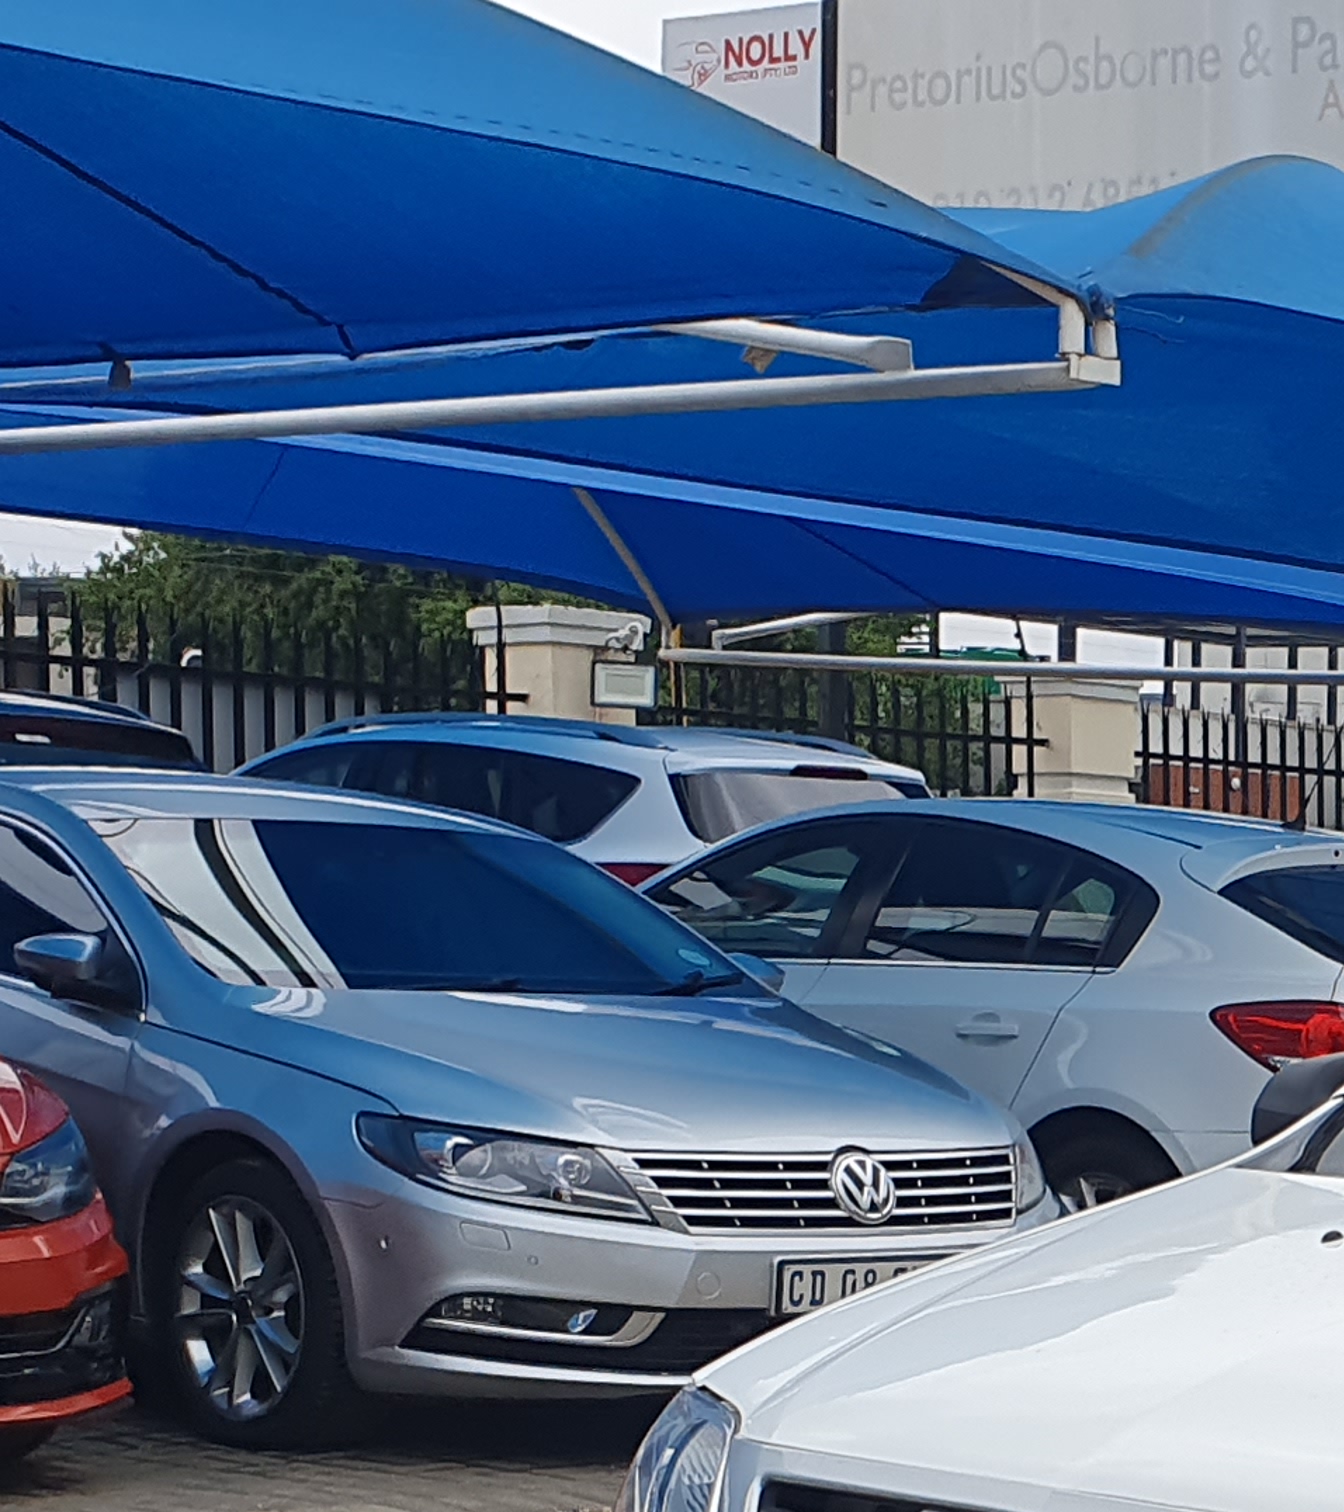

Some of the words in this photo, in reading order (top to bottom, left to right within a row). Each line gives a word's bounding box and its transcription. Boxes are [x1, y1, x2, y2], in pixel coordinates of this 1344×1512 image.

[724, 28, 817, 70] NOLLY
[1238, 22, 1272, 79] &
[789, 1269, 826, 1307] CD
